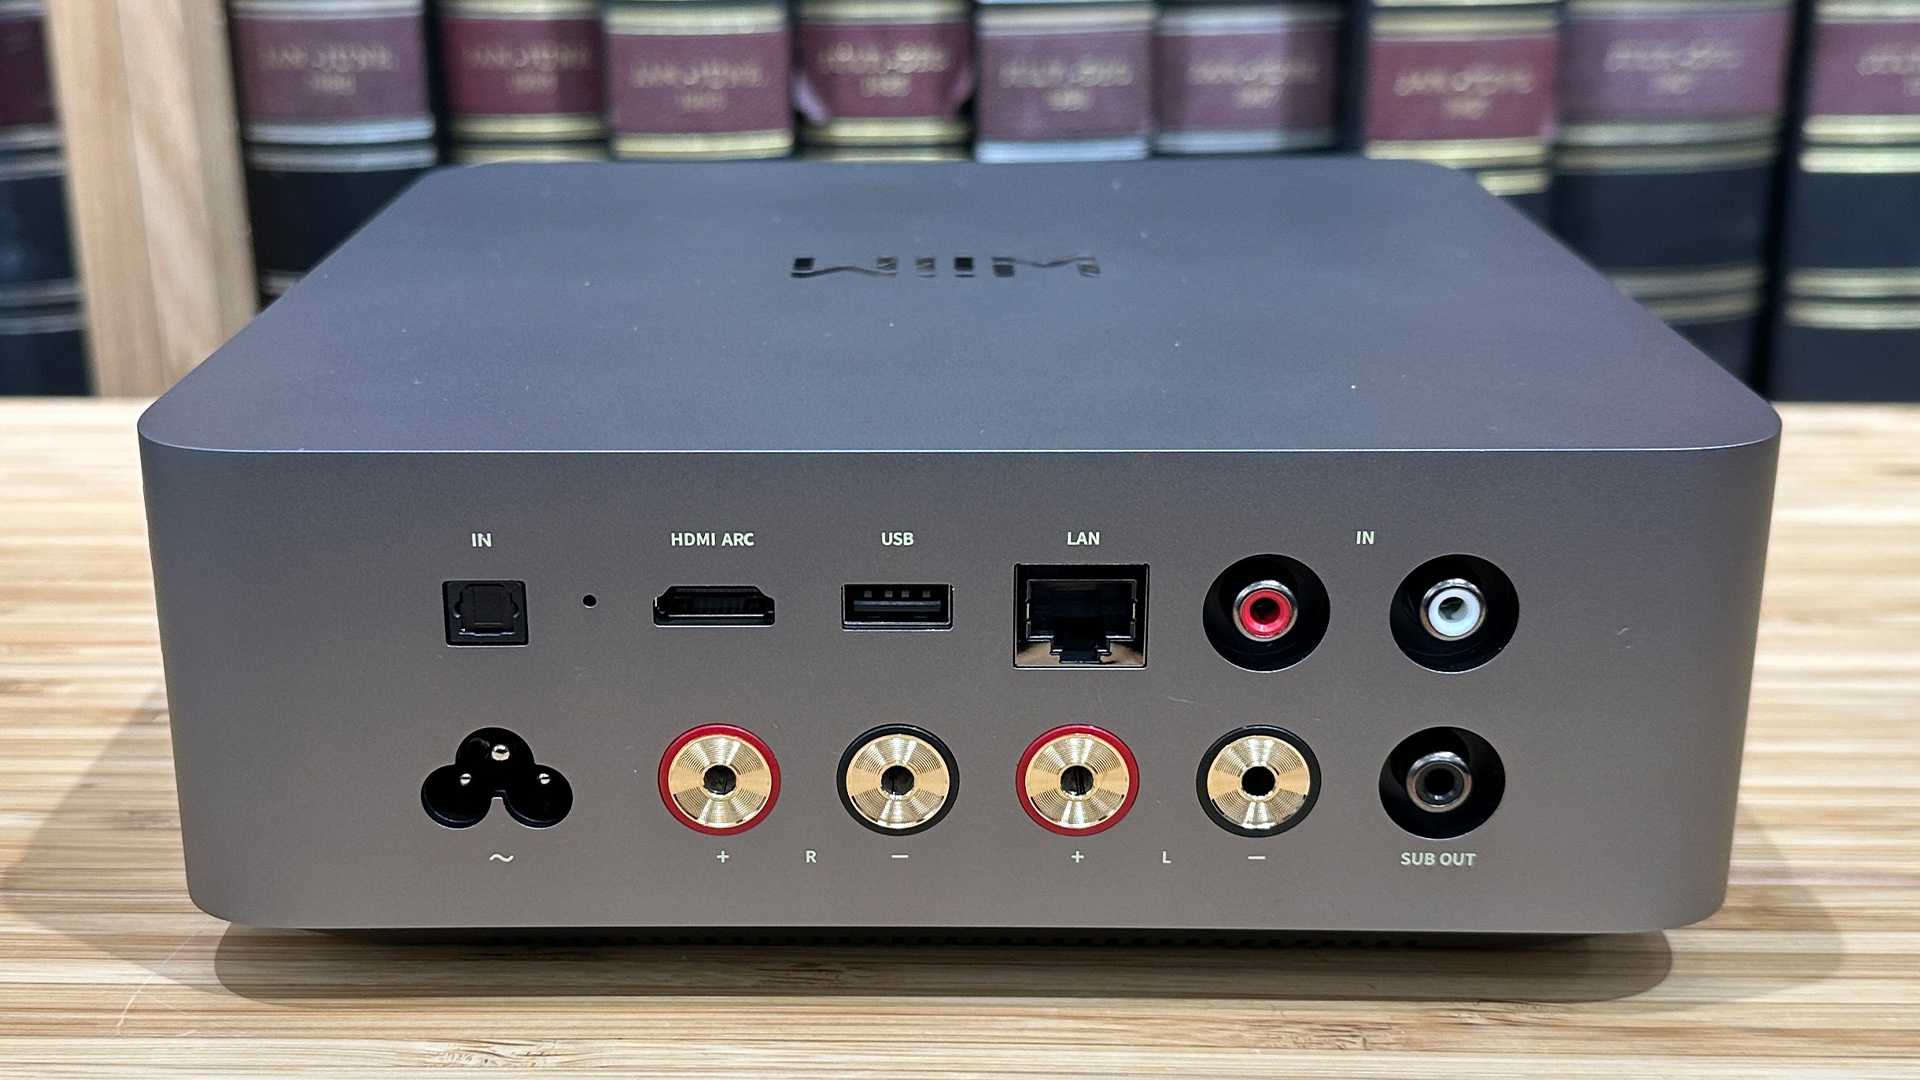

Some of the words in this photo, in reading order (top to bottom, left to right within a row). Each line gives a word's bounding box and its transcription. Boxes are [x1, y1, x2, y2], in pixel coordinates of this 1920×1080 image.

[471, 533, 492, 547] IN
[670, 532, 717, 547] HDMI
[720, 532, 756, 547] ARC
[880, 532, 915, 547] USB
[1066, 531, 1101, 546] LAN
[1356, 530, 1375, 545] IN
[805, 850, 817, 864] R
[1161, 851, 1172, 865] L
[1400, 852, 1436, 867] SUB
[1439, 852, 1477, 867] OUT
